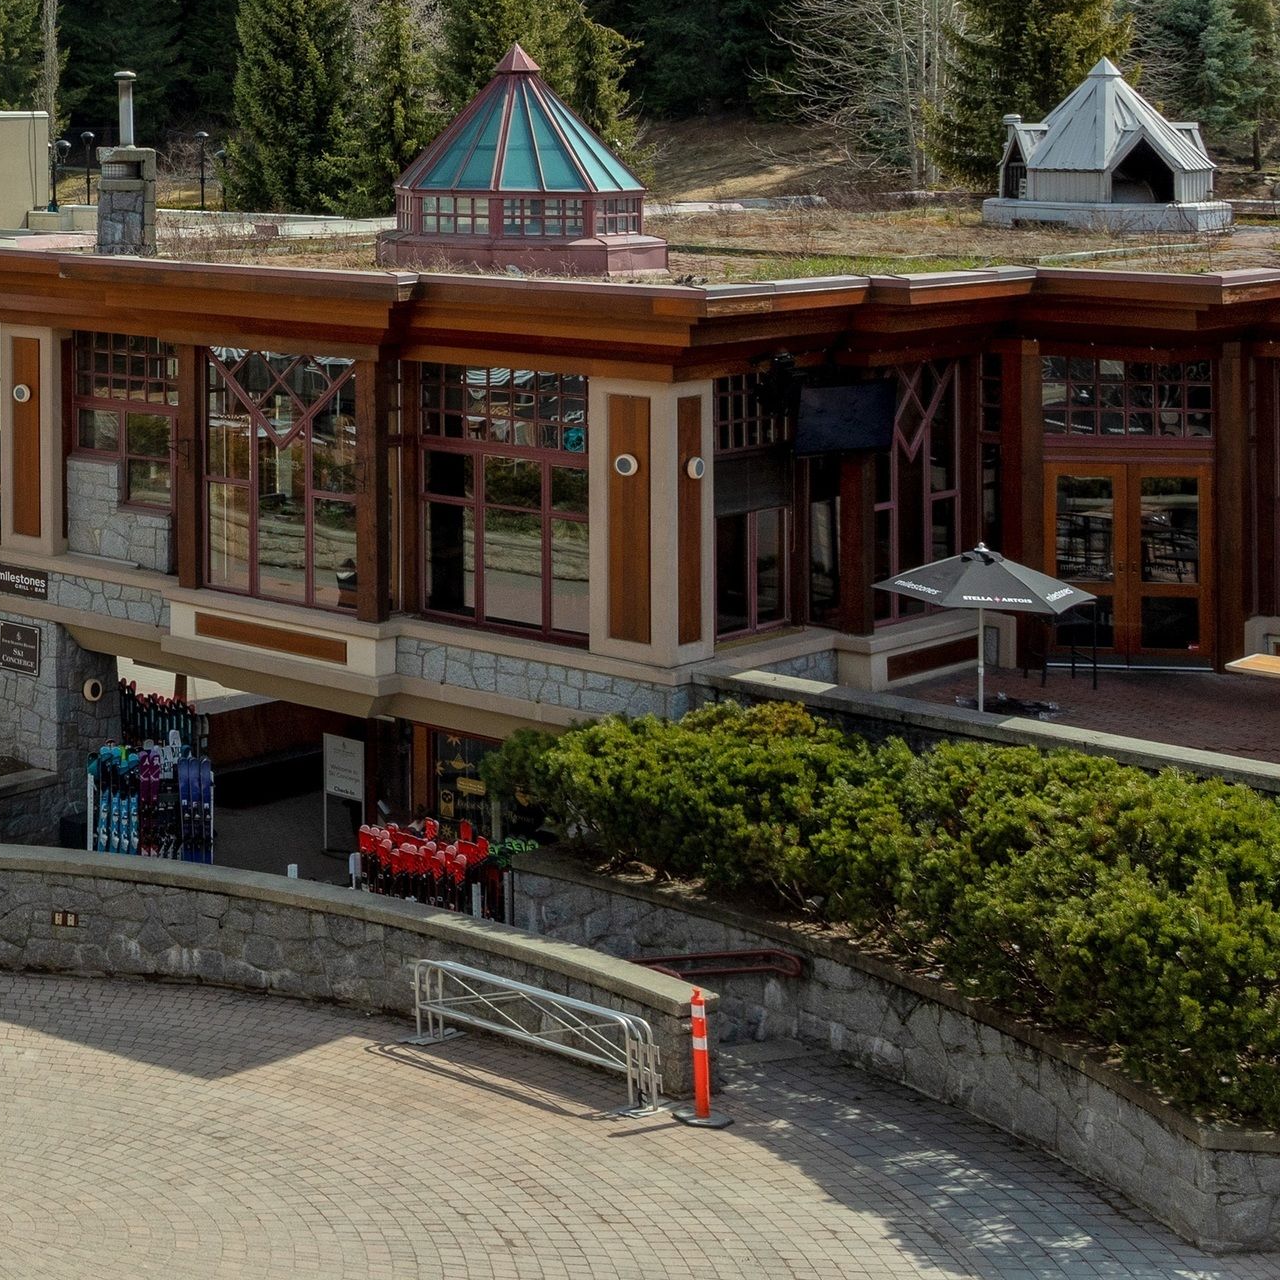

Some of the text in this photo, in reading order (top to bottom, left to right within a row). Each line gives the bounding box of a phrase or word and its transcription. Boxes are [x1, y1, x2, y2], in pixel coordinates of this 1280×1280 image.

[14, 583, 30, 591] GRILL
[894, 579, 940, 596] milestones
[962, 595, 993, 603] STELLA
[1, 654, 36, 668] CONCIERGE
